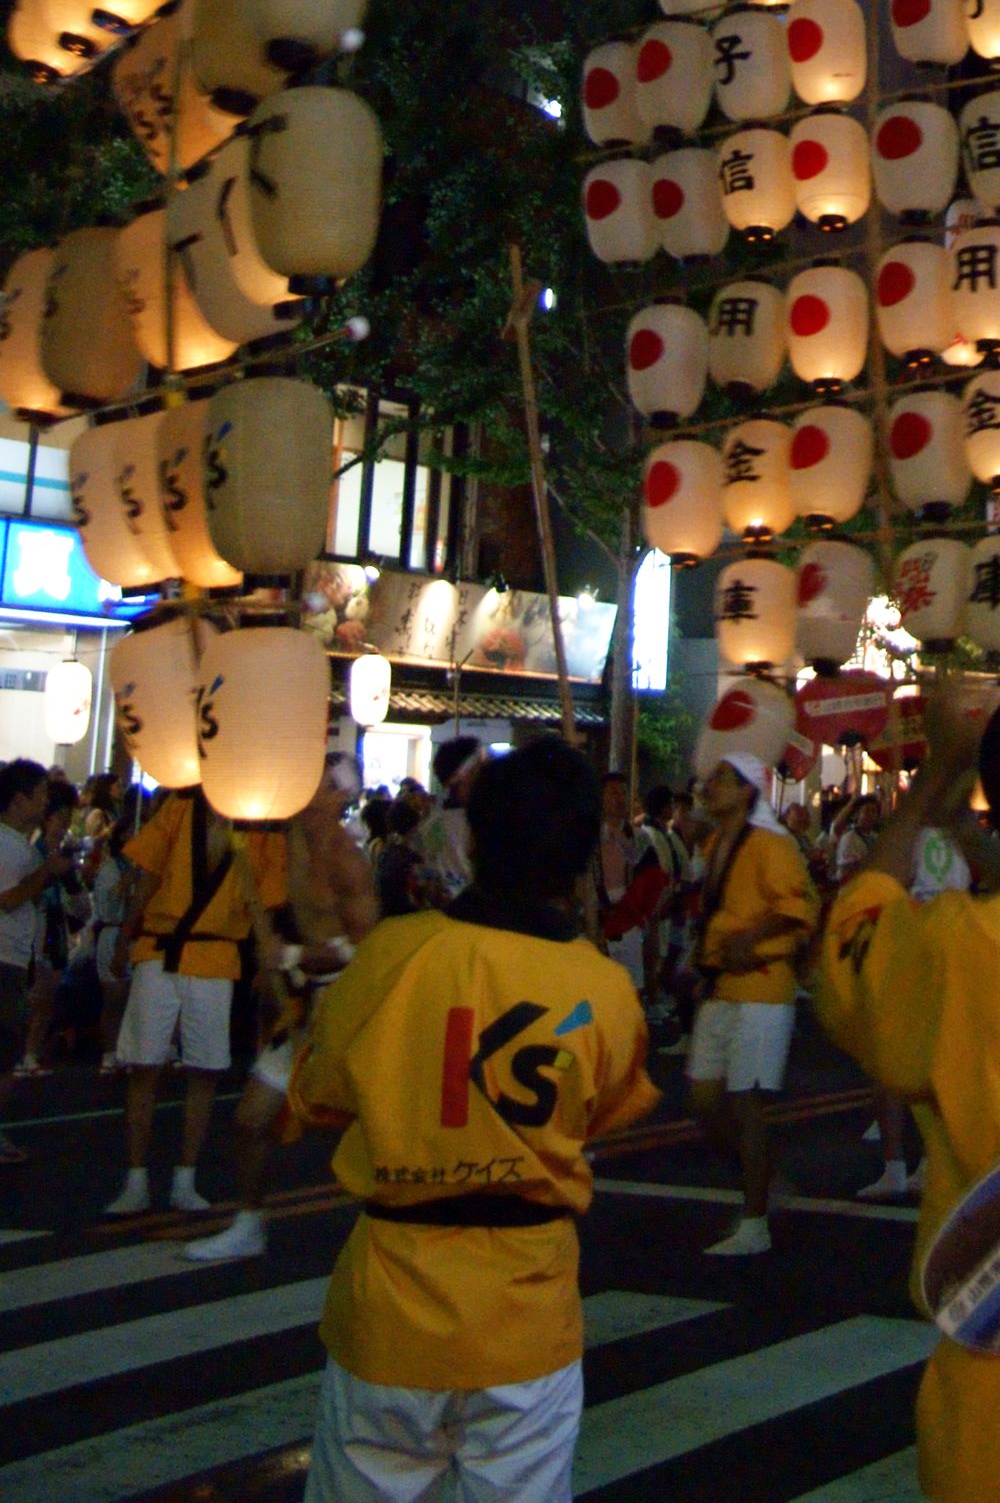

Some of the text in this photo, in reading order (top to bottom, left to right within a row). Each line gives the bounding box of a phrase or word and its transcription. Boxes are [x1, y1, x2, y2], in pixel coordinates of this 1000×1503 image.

[712, 35, 750, 85] 子
[719, 149, 756, 195] 信
[952, 243, 998, 292] 用
[710, 298, 756, 338] 用
[724, 439, 766, 486] 金
[718, 578, 760, 624] 庫
